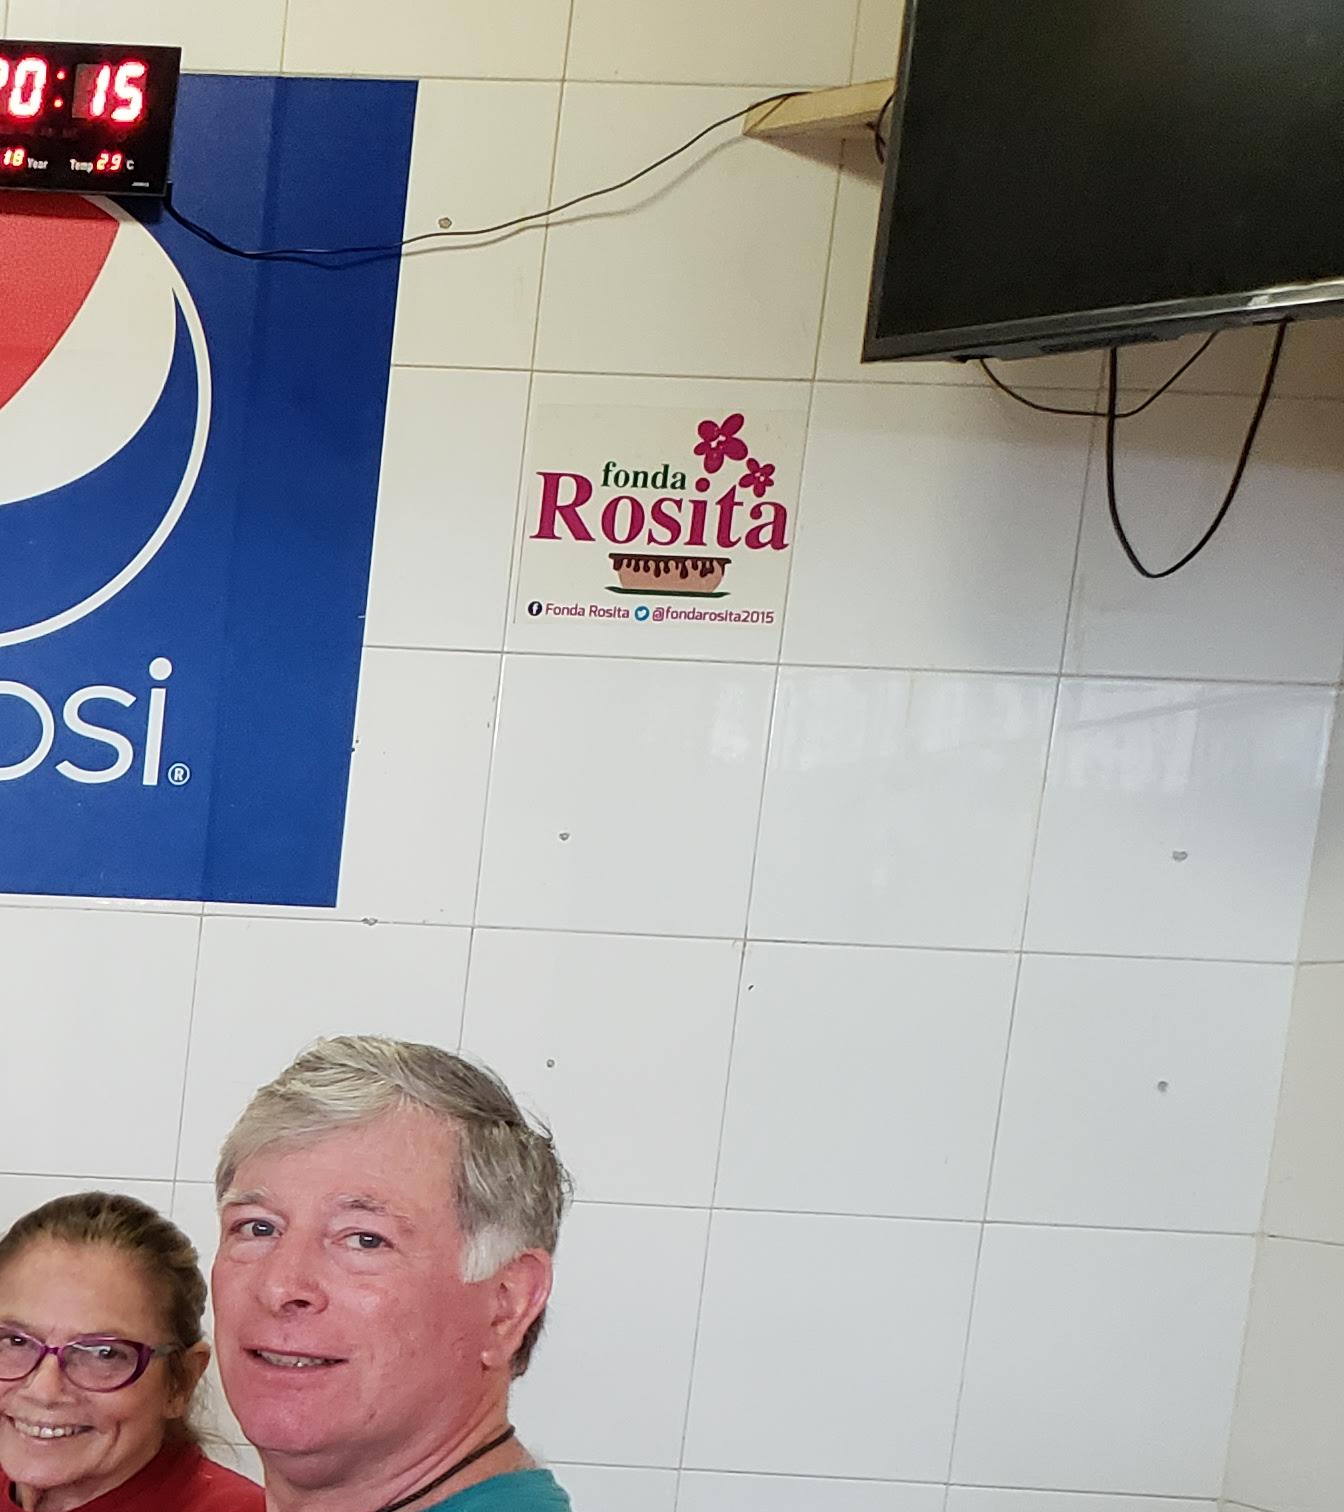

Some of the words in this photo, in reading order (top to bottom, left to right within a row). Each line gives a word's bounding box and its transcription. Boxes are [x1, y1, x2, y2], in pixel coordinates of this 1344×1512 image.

[27, 157, 49, 170] Year
[601, 460, 686, 490] fonda
[529, 471, 789, 550] Rosita
[545, 602, 586, 617] Fonda
[589, 604, 630, 620] Rosita
[652, 606, 774, 625] @fondarosita2015
